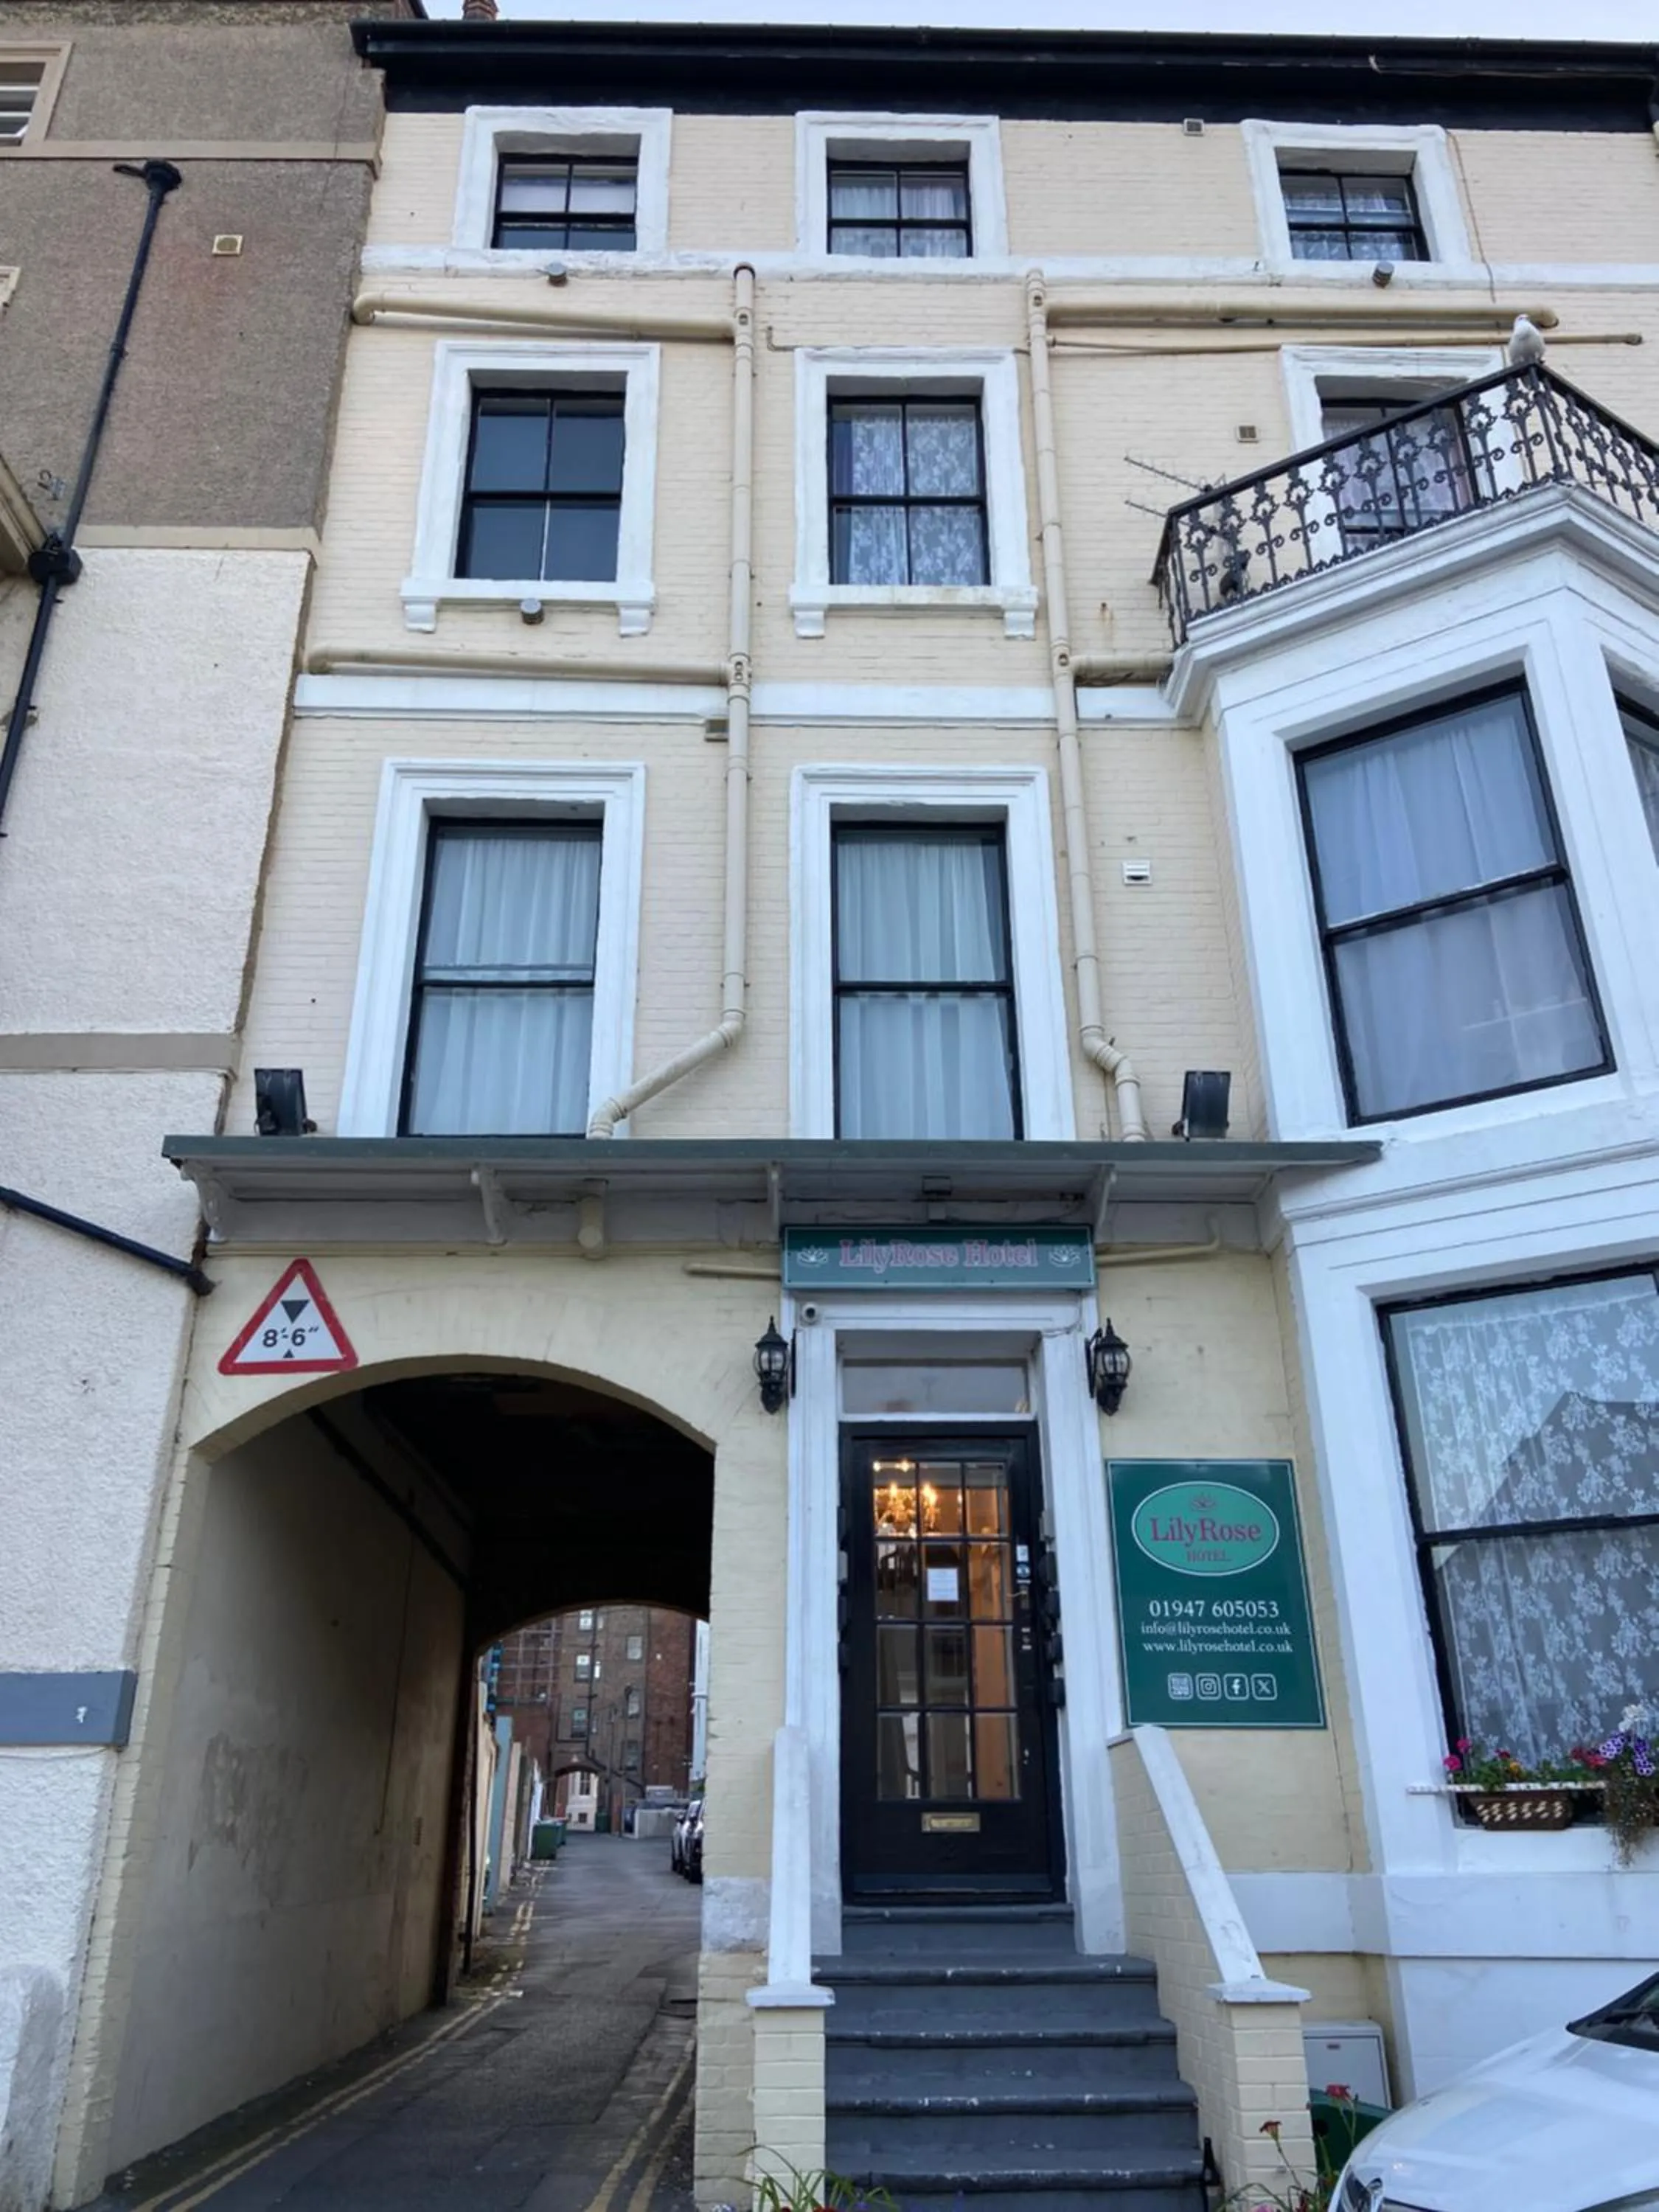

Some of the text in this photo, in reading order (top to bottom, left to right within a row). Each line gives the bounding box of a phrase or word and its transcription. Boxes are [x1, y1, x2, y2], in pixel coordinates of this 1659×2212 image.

[839, 1239, 1039, 1273] LilyRose Hotel
[1150, 1517, 1261, 1547] LilyRose
[1187, 1550, 1231, 1562] HOTEL
[1149, 1599, 1279, 1618] 01947 605053
[1141, 1621, 1291, 1637] info@lilyrosehotel.co.uk
[1143, 1639, 1293, 1654] www.lilyrosehotel.co.uk
